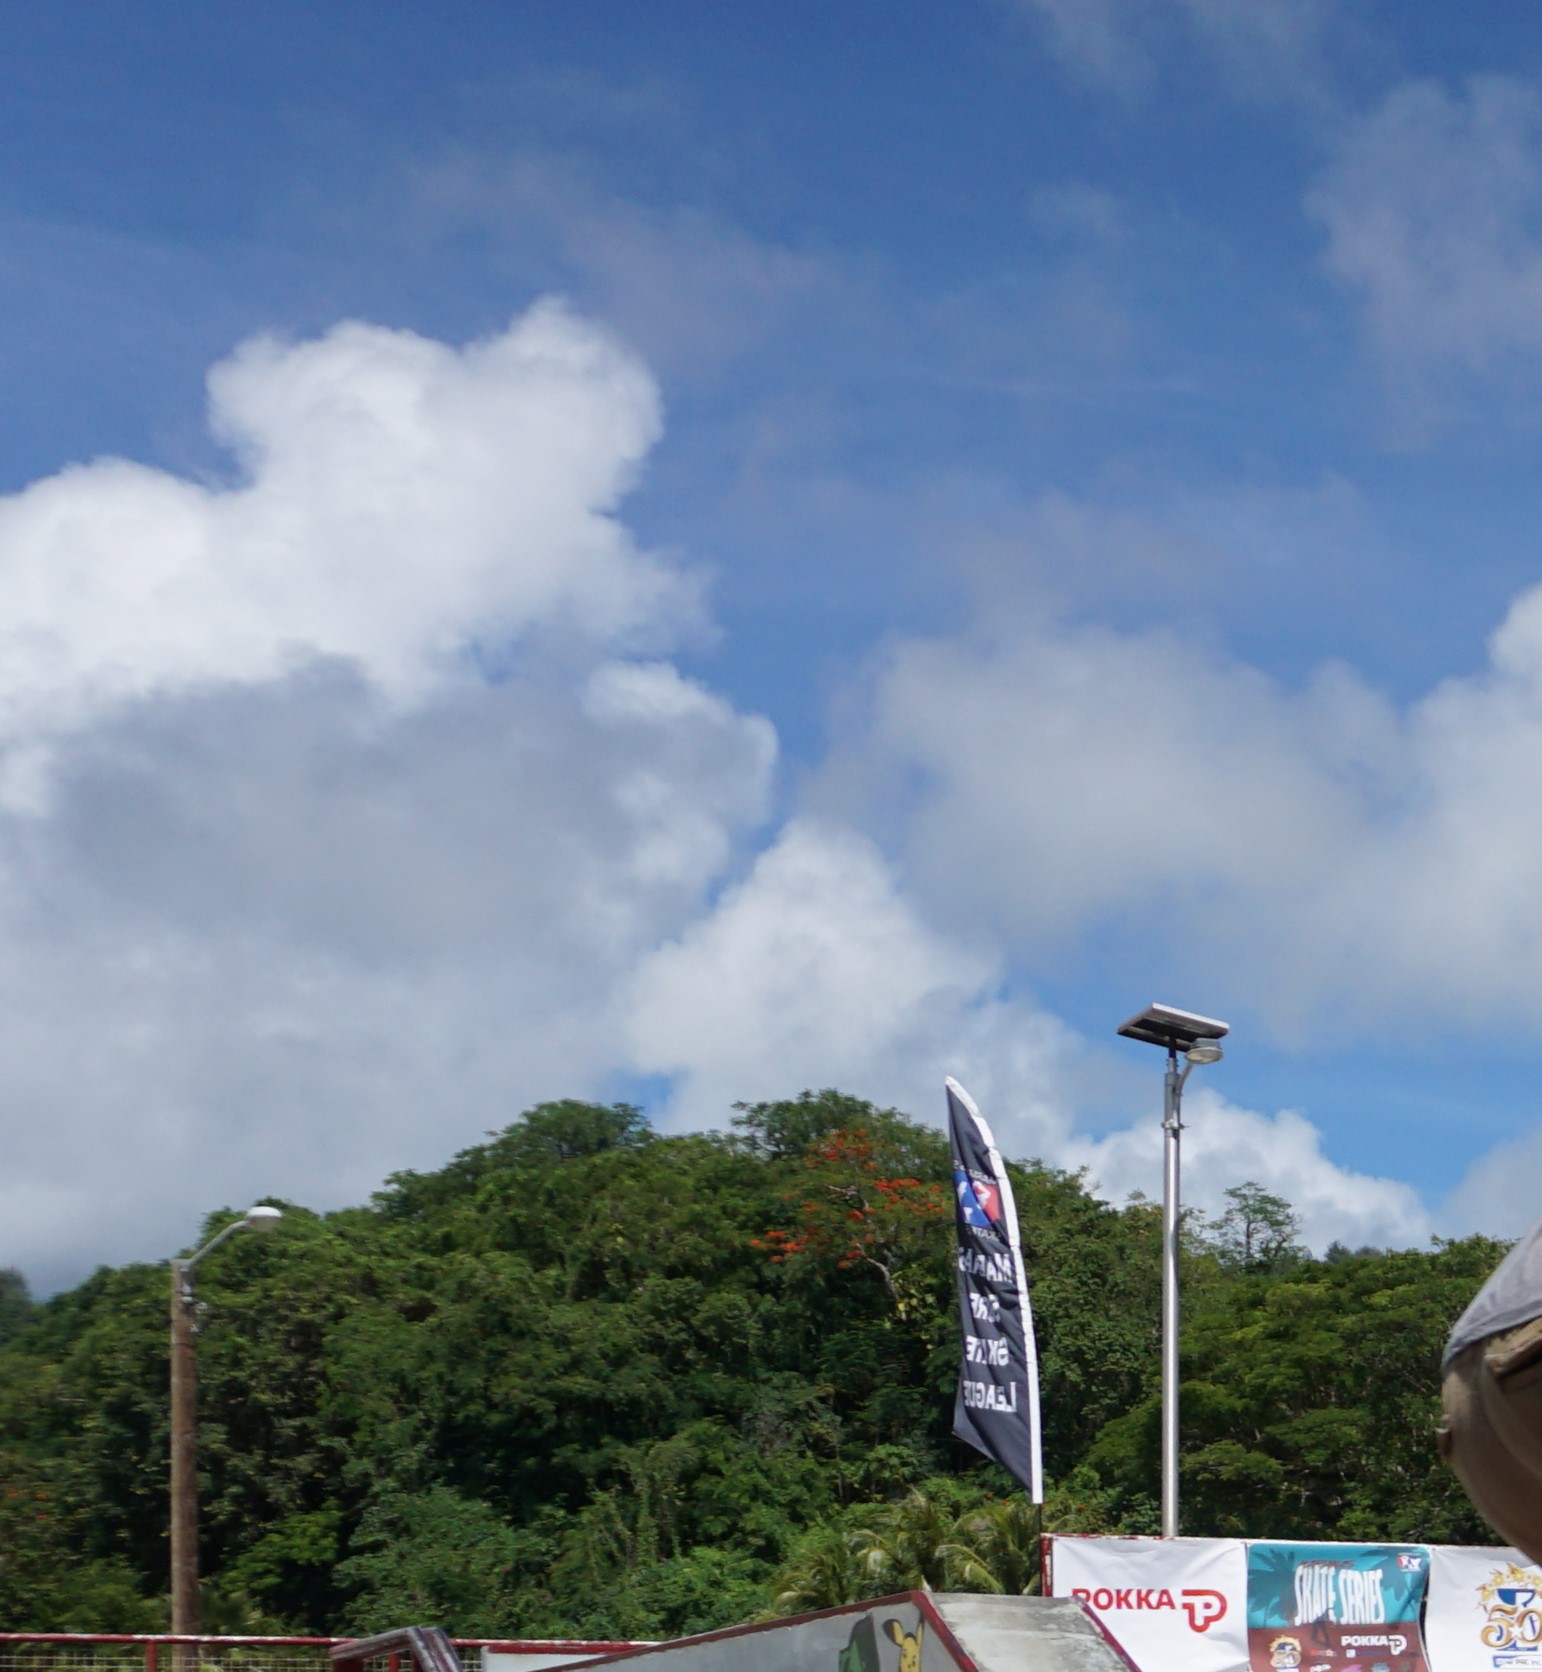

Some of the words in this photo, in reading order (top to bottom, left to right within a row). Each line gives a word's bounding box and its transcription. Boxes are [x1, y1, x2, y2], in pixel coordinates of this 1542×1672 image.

[1294, 1564, 1336, 1627] SKATE
[1338, 1569, 1385, 1625] SERIES
[1341, 1635, 1388, 1647] POKKA
